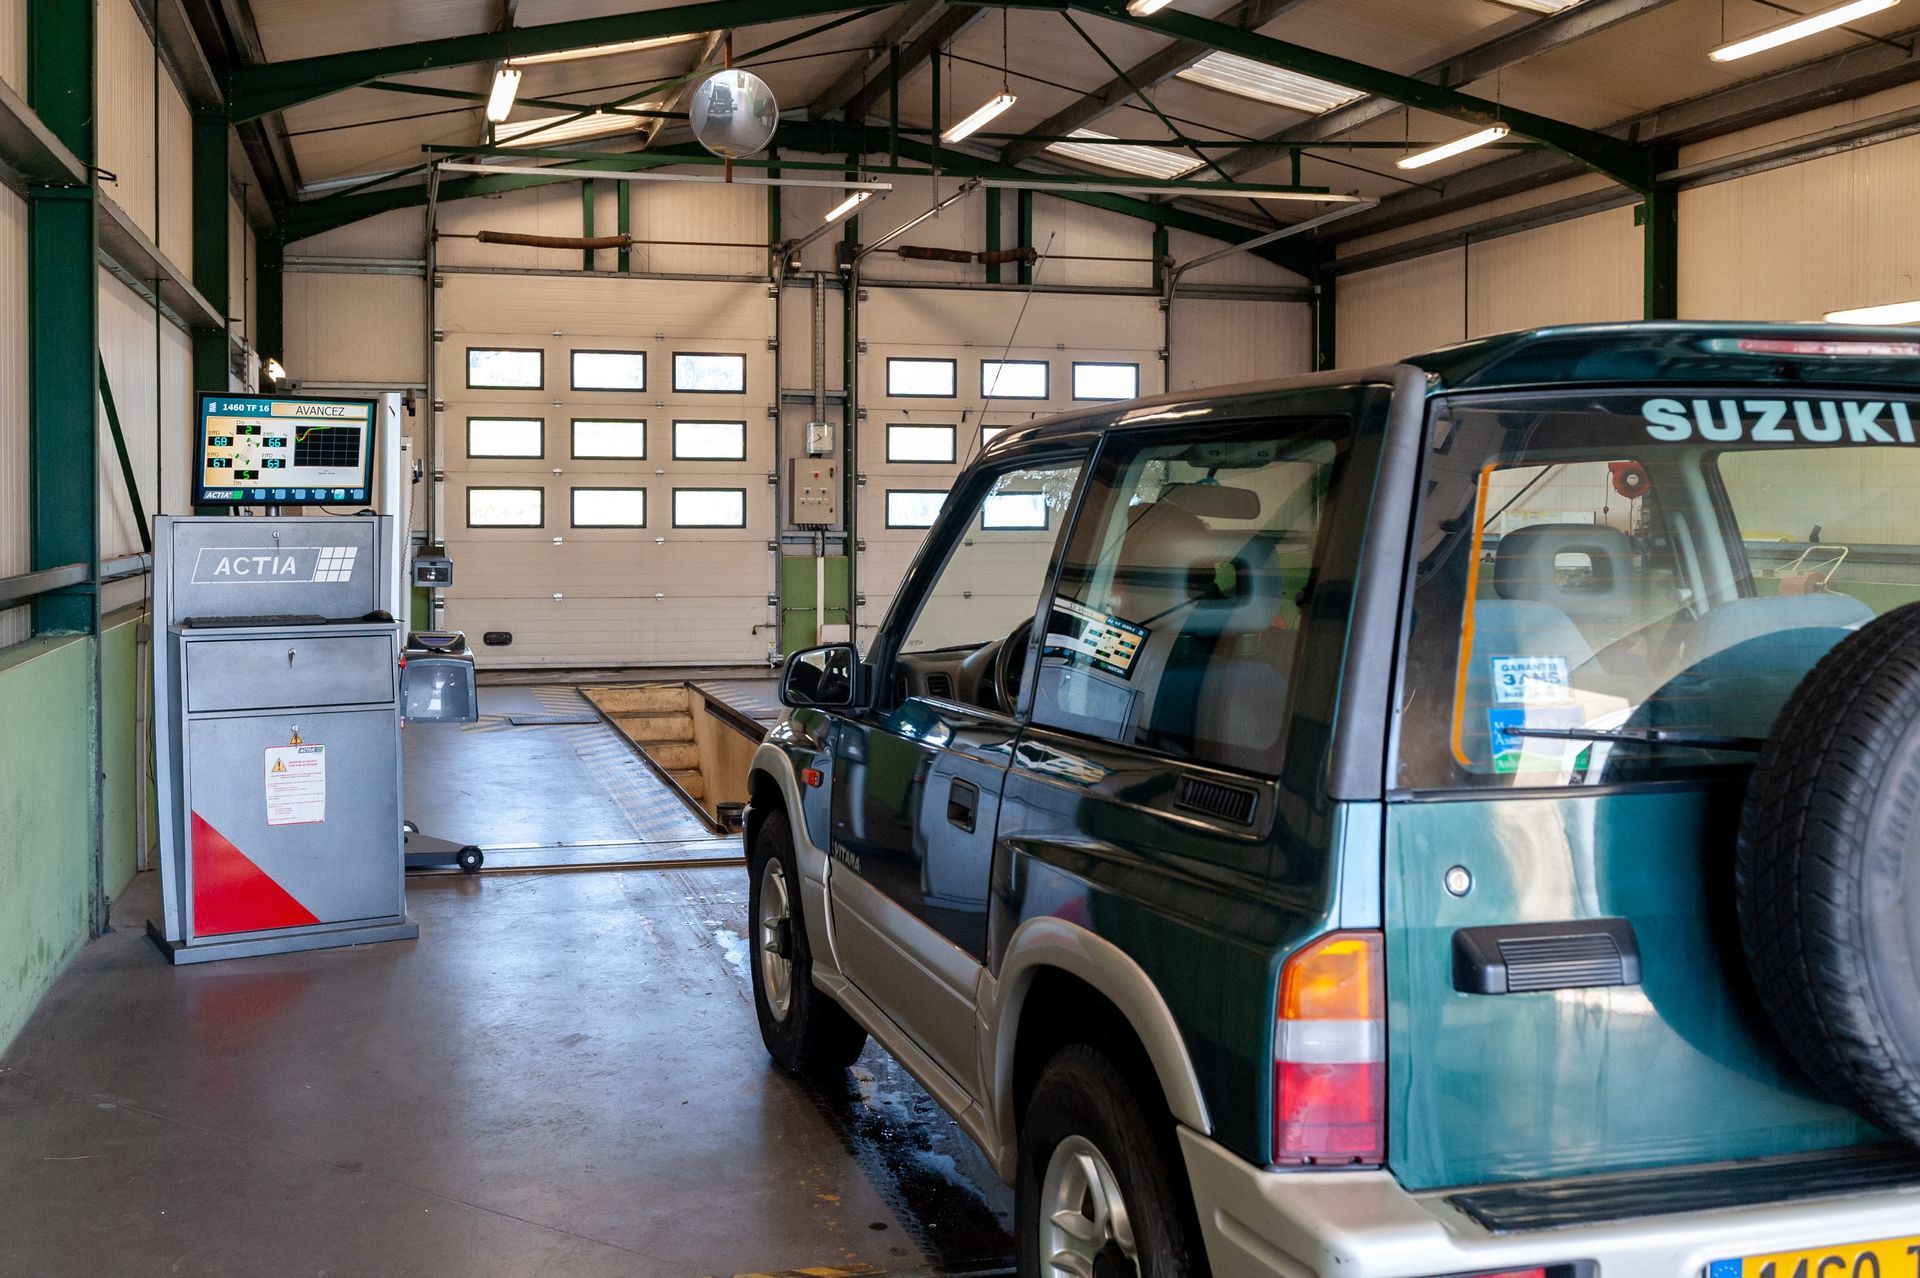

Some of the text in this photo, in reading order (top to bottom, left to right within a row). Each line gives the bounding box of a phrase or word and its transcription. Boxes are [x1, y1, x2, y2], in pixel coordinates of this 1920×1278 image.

[222, 403, 245, 411] 1460
[246, 404, 257, 412] TF
[295, 405, 345, 417] AVANCEZ
[1641, 398, 1916, 443] SUZUKI
[245, 426, 252, 435] 2
[214, 436, 228, 446] 68
[213, 458, 226, 468] 67
[267, 459, 280, 468] 63
[213, 556, 296, 575] ACTIA
[1503, 673, 1517, 686] 3
